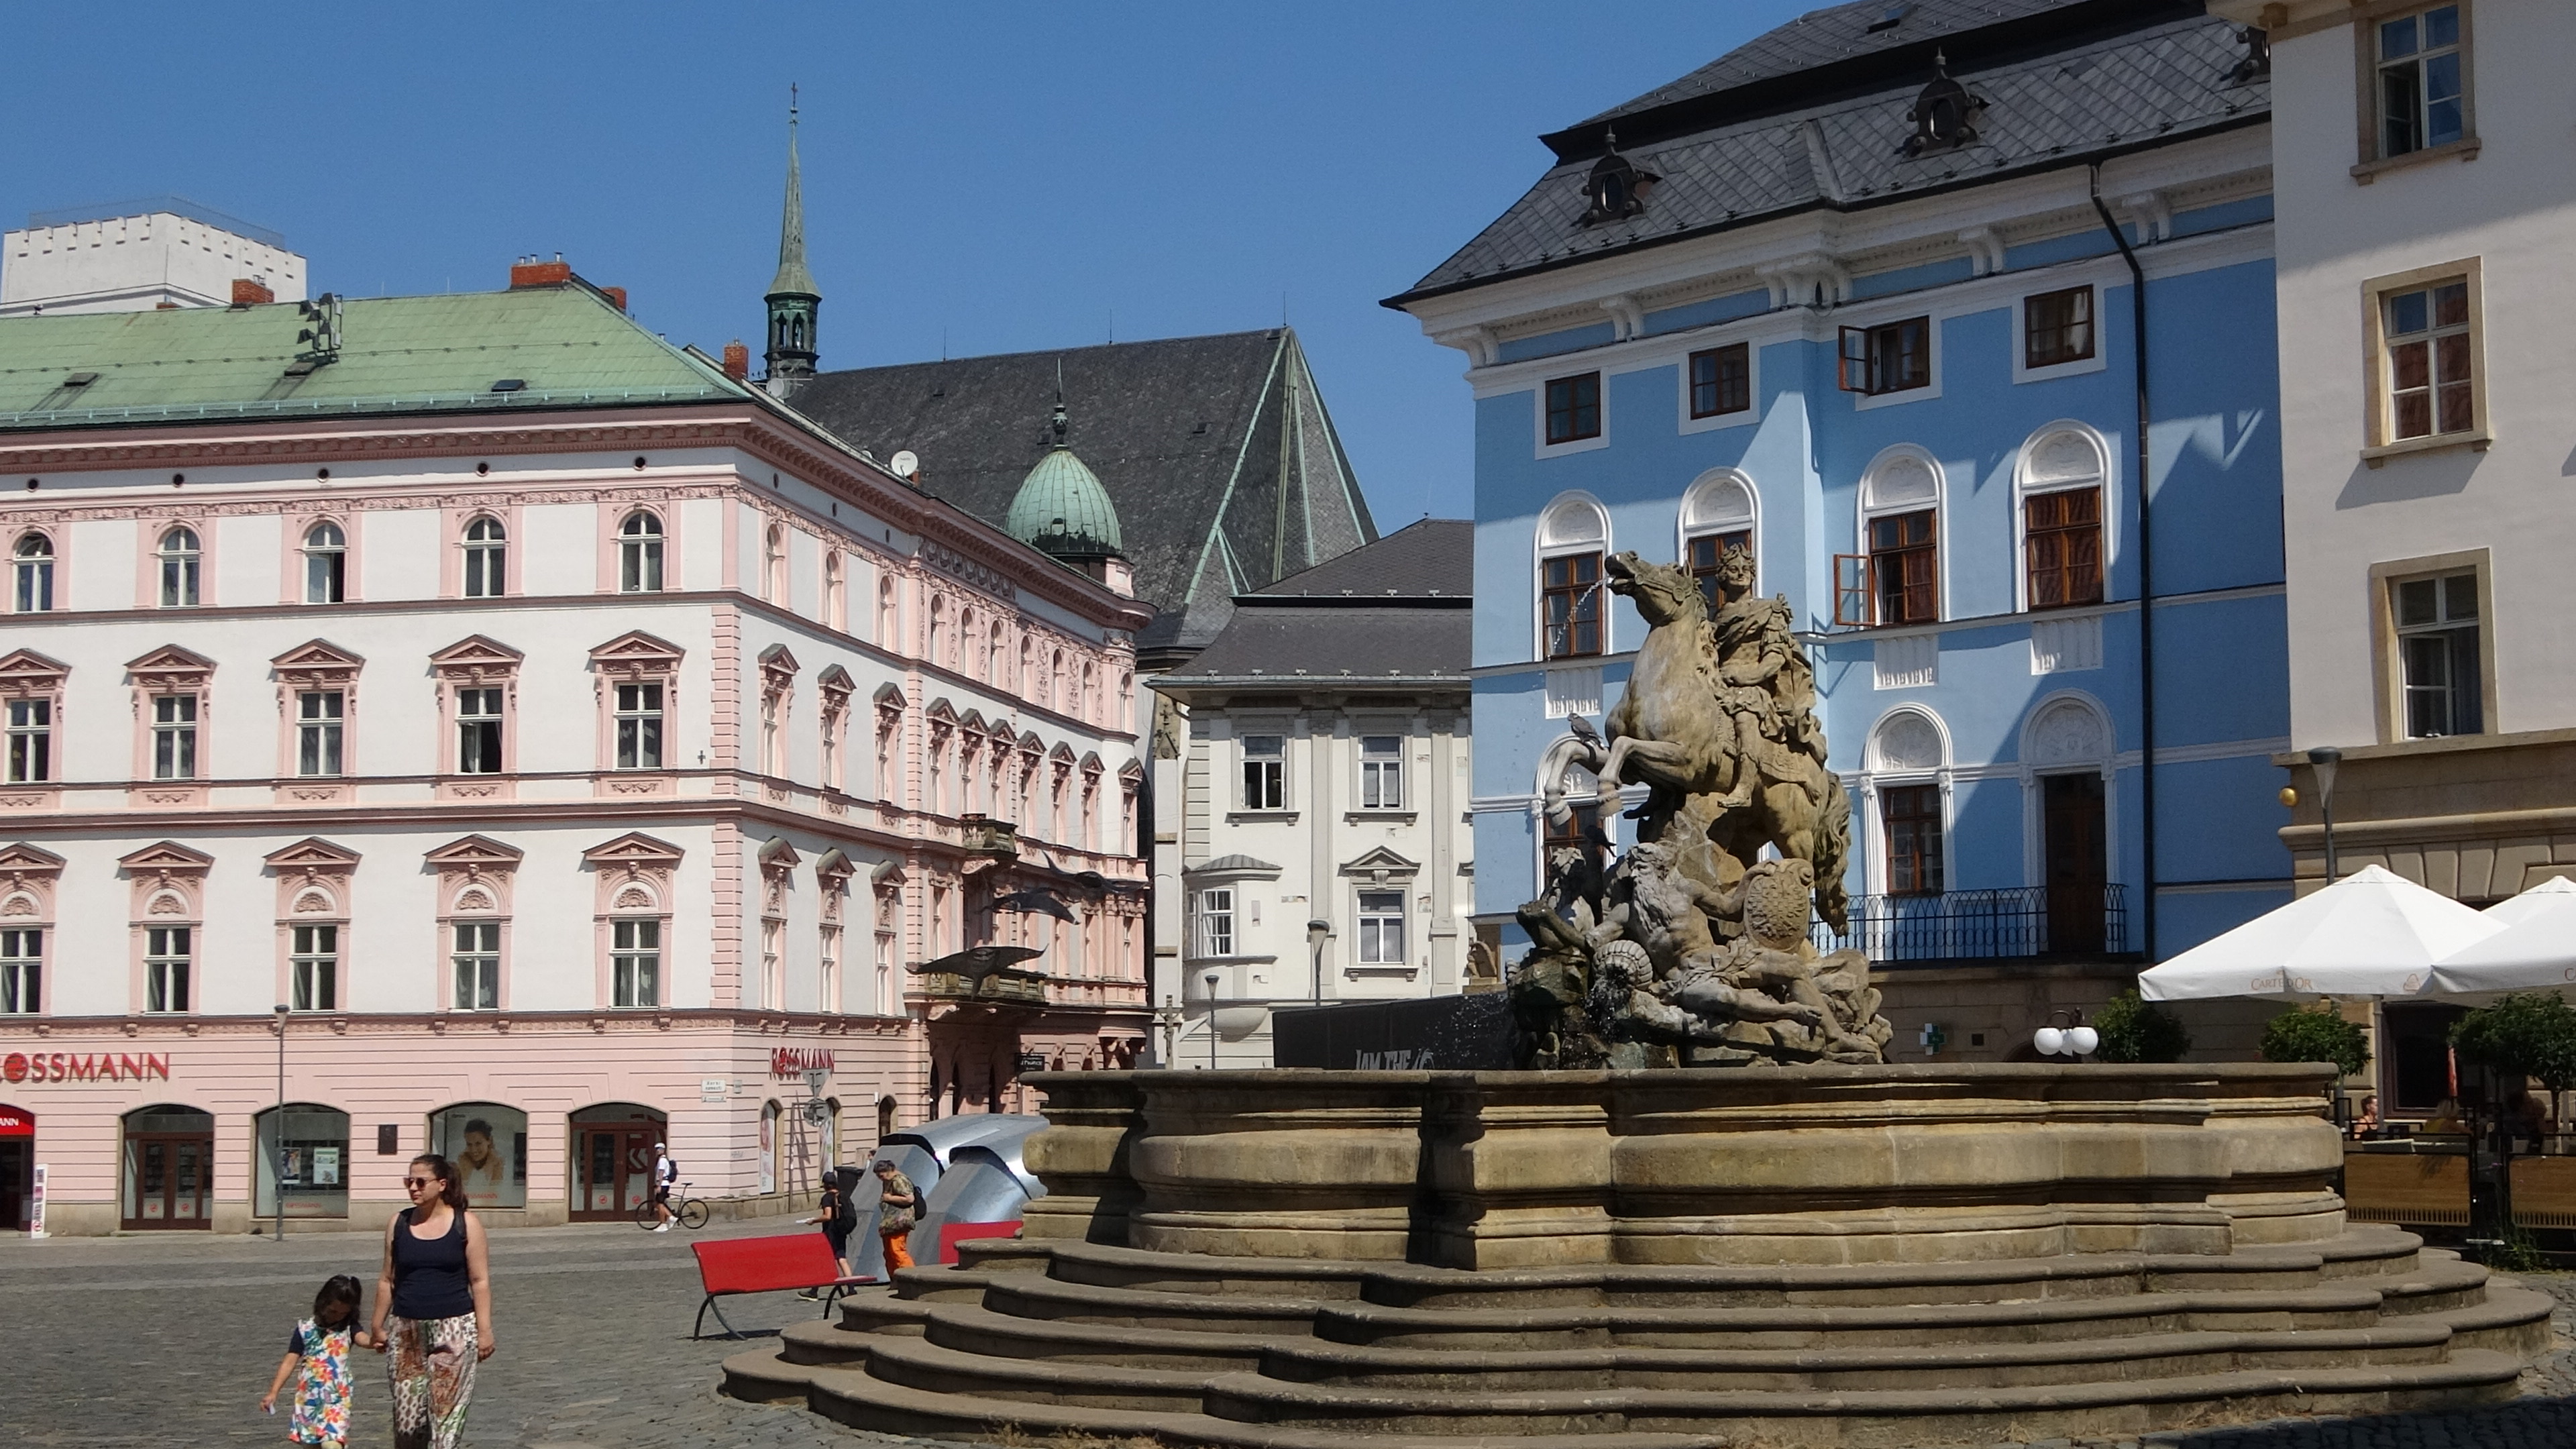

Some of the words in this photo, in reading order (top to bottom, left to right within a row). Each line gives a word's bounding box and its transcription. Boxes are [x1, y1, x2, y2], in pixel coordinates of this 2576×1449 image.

[2251, 977, 2283, 991] CARTE
[0, 1052, 170, 1083] OSSMANN
[771, 1046, 835, 1075] ROSSMANN
